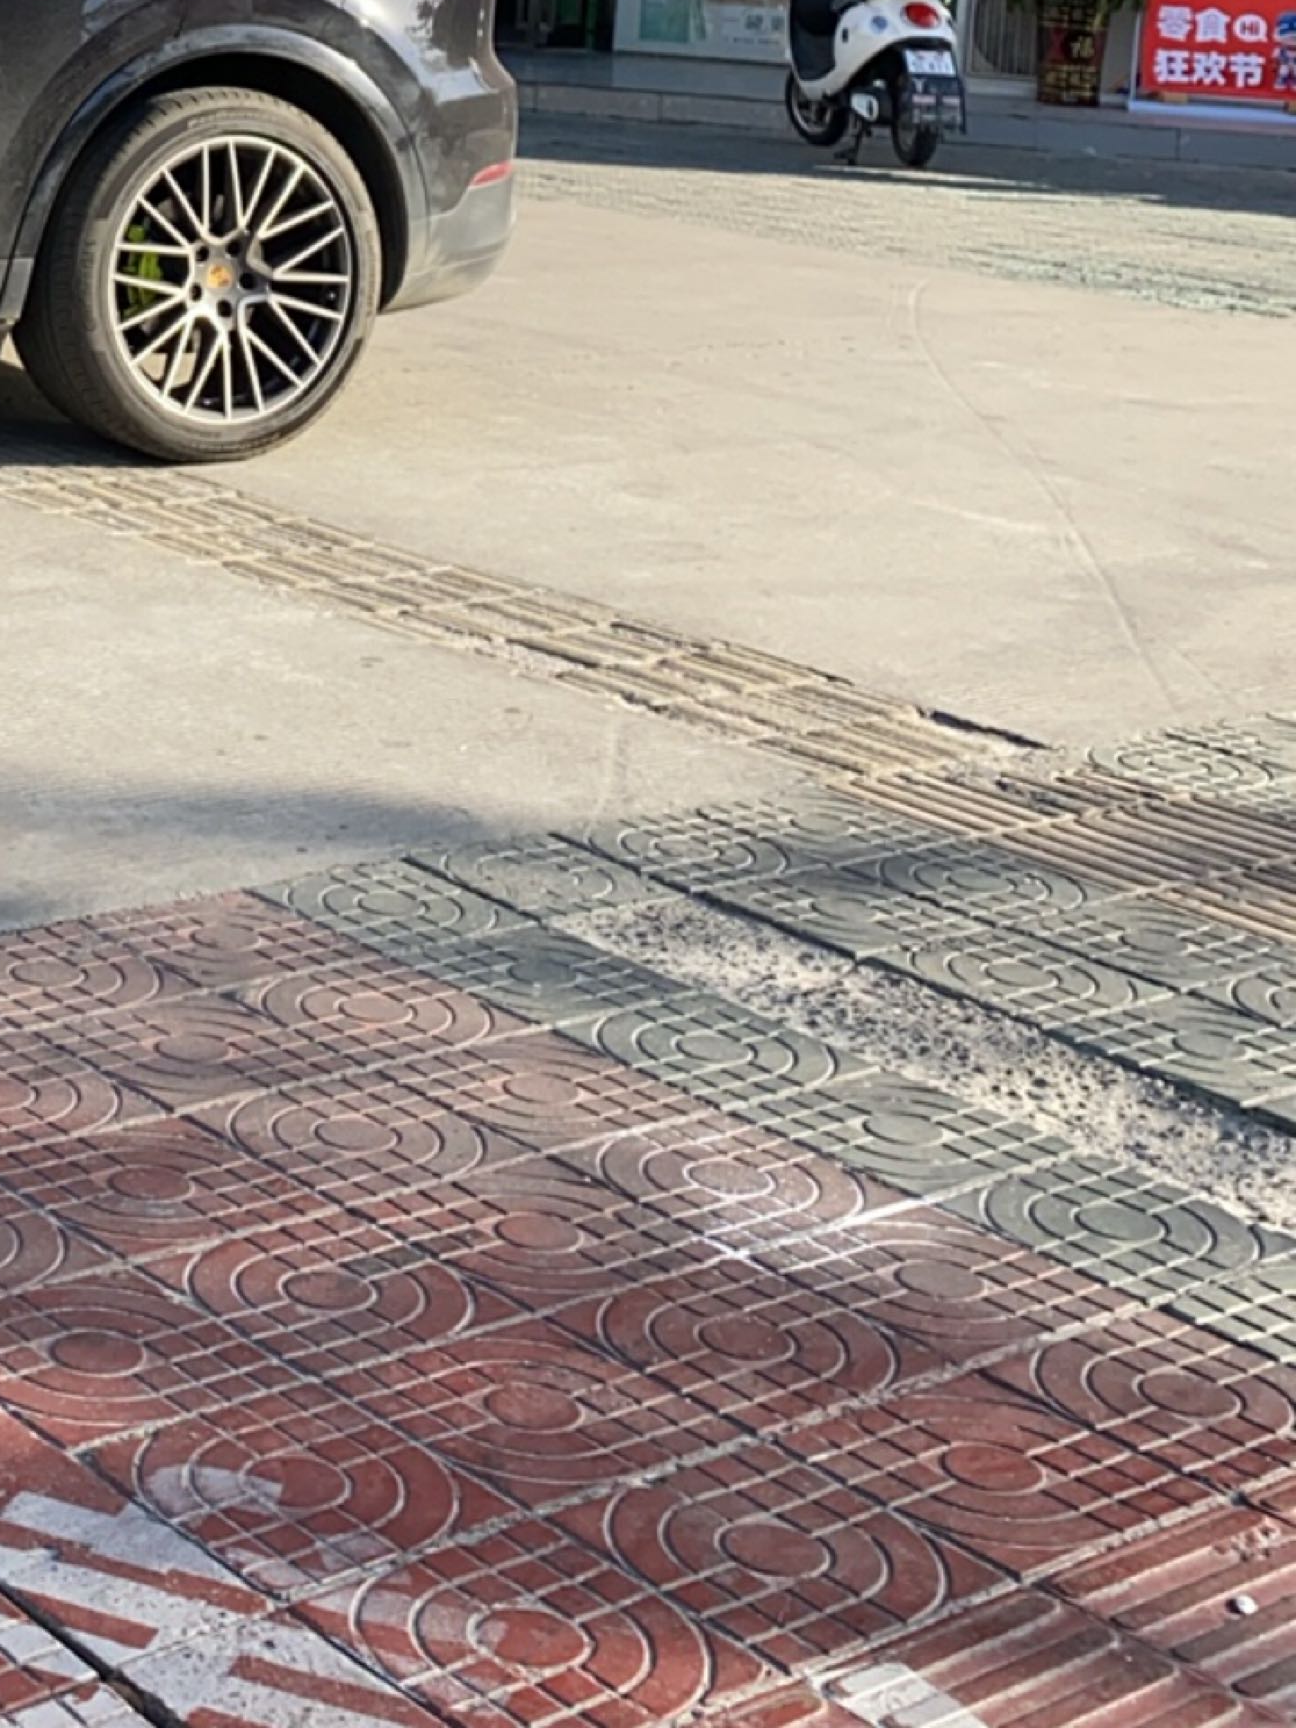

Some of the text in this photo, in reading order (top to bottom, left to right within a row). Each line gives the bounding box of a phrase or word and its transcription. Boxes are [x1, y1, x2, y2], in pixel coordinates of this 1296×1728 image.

[1157, 5, 1230, 44] 零食
[1153, 48, 1266, 88] 狂欢节
